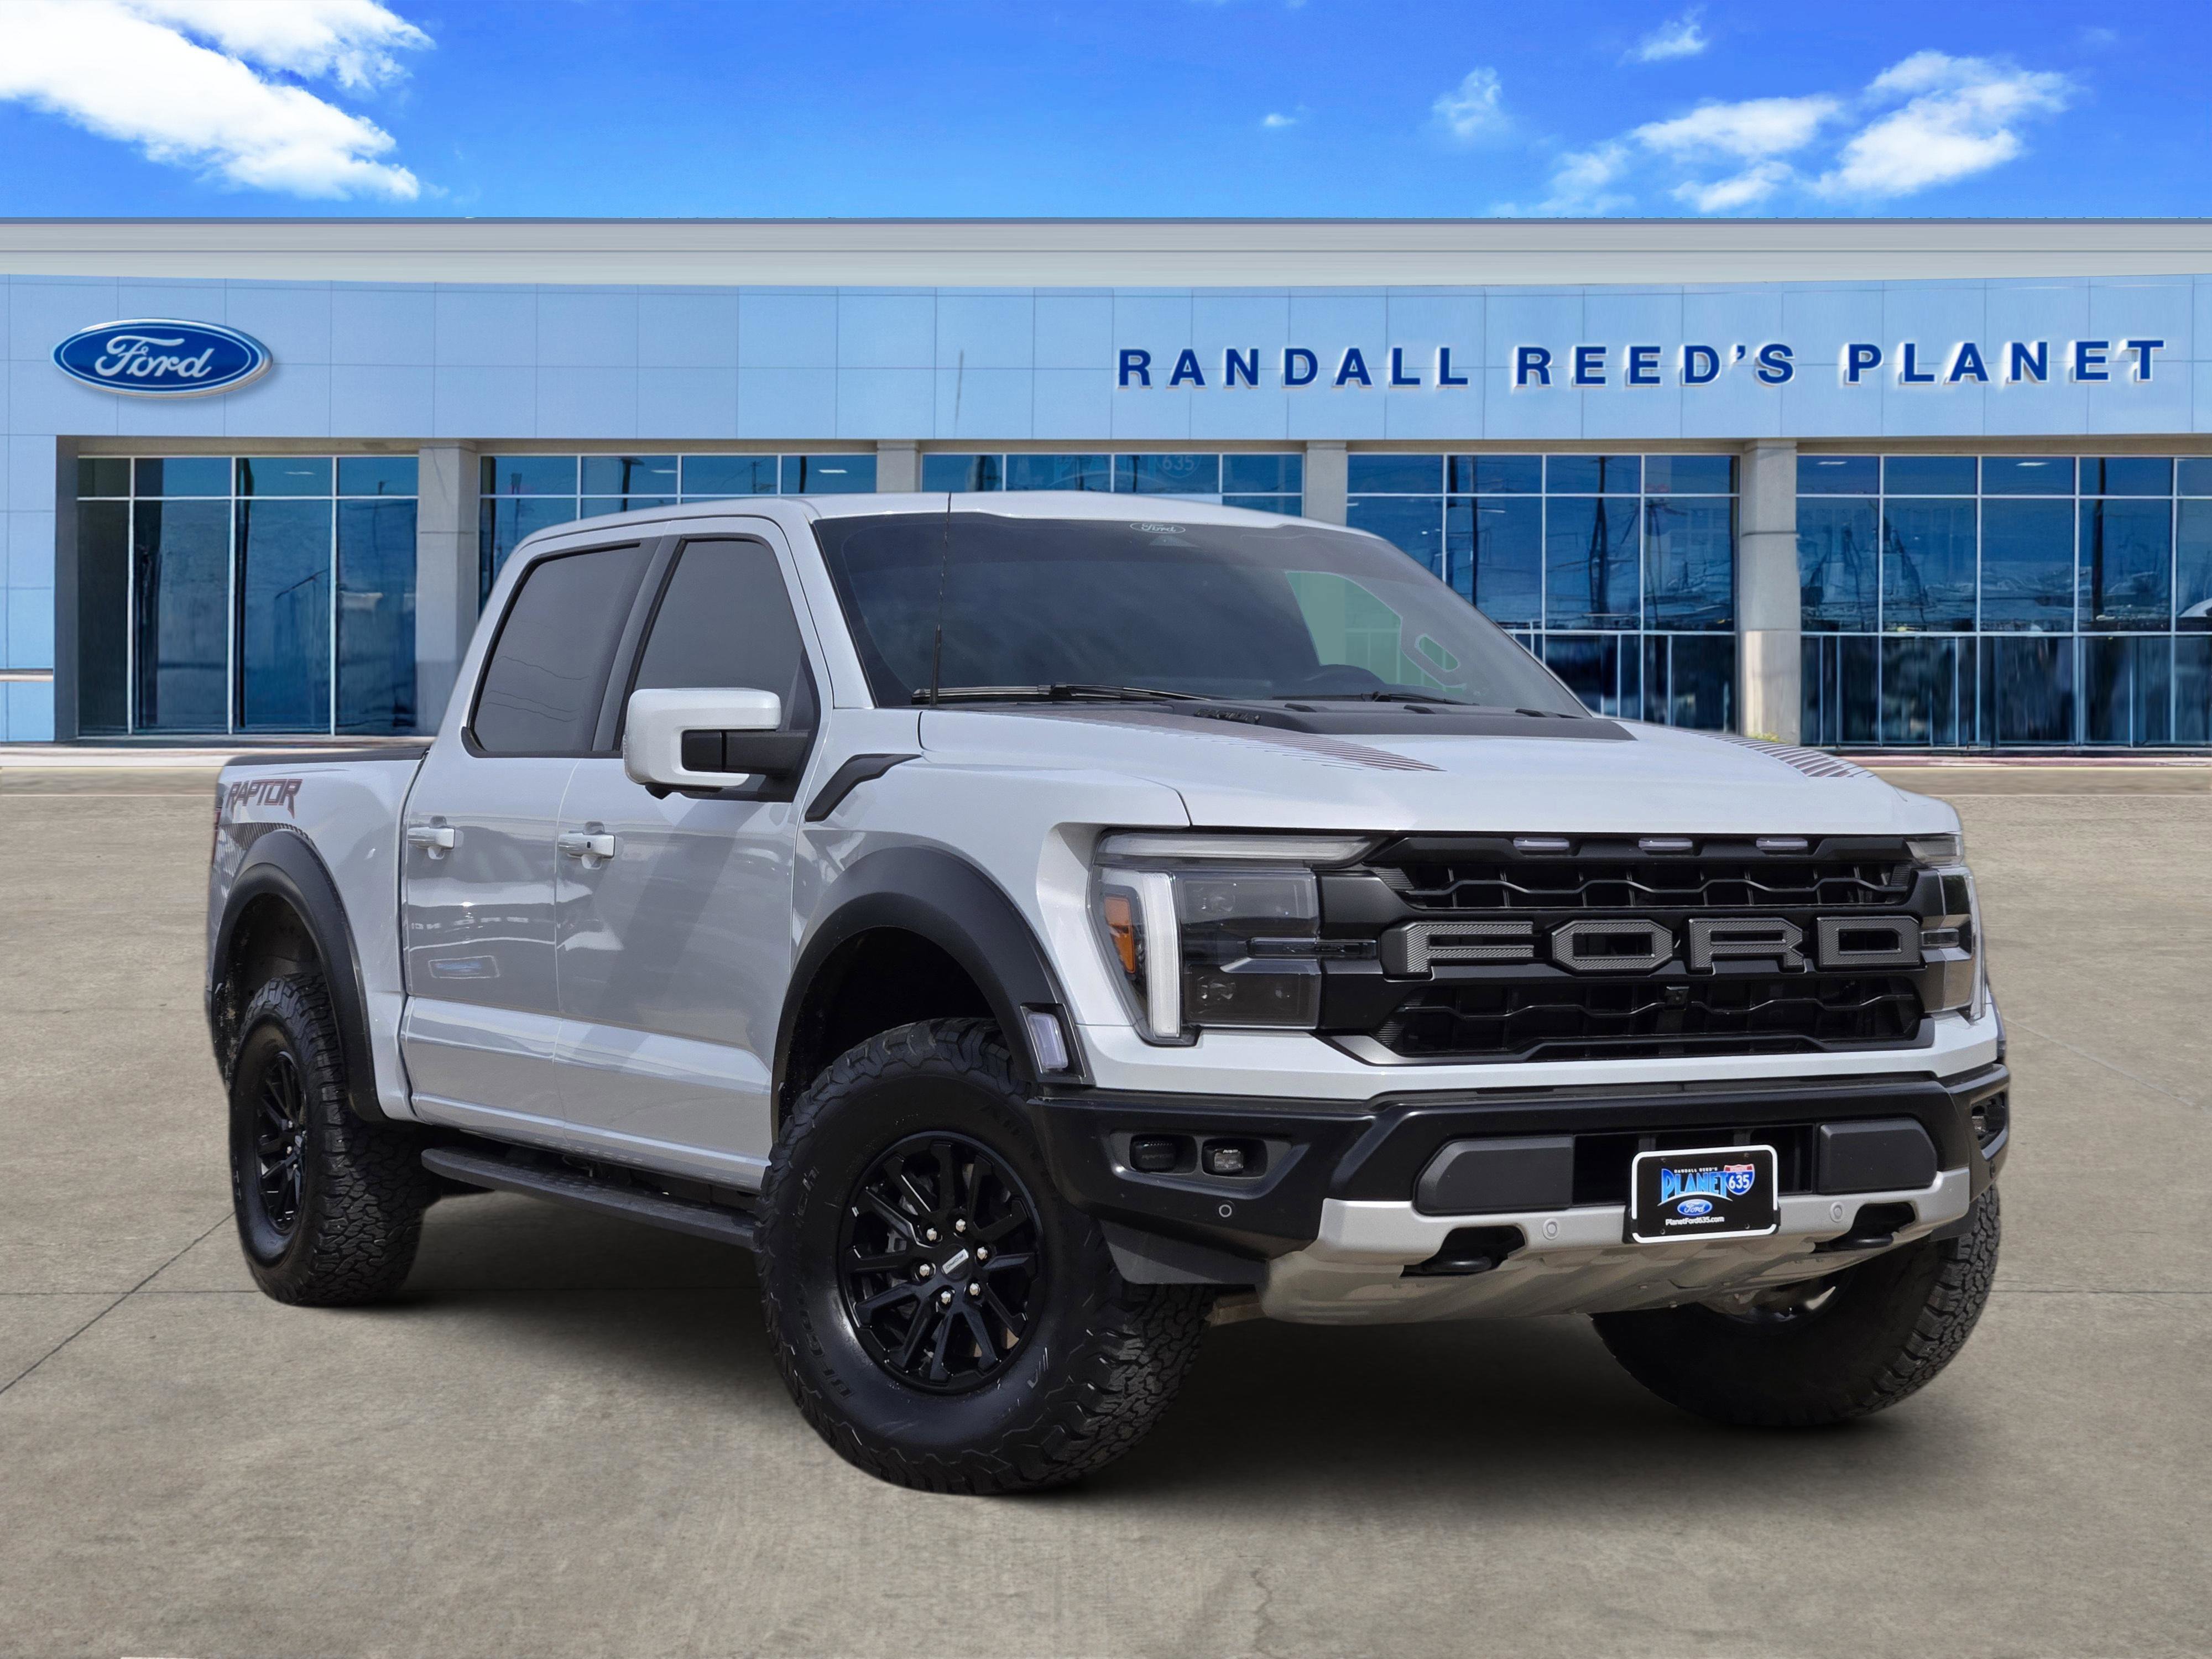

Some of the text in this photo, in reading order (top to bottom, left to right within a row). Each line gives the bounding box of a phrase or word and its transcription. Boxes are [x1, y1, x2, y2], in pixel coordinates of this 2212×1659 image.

[95, 335, 215, 378] Ford
[1118, 340, 2164, 387] RANDALL REED'S PLANET
[225, 779, 303, 819] RAPTOR
[1396, 915, 1921, 977] FORD
[1661, 1168, 1750, 1203] PLANET 635
[1665, 1216, 1724, 1226] PlanetFord635.com
[1684, 1203, 1704, 1213] Ford
